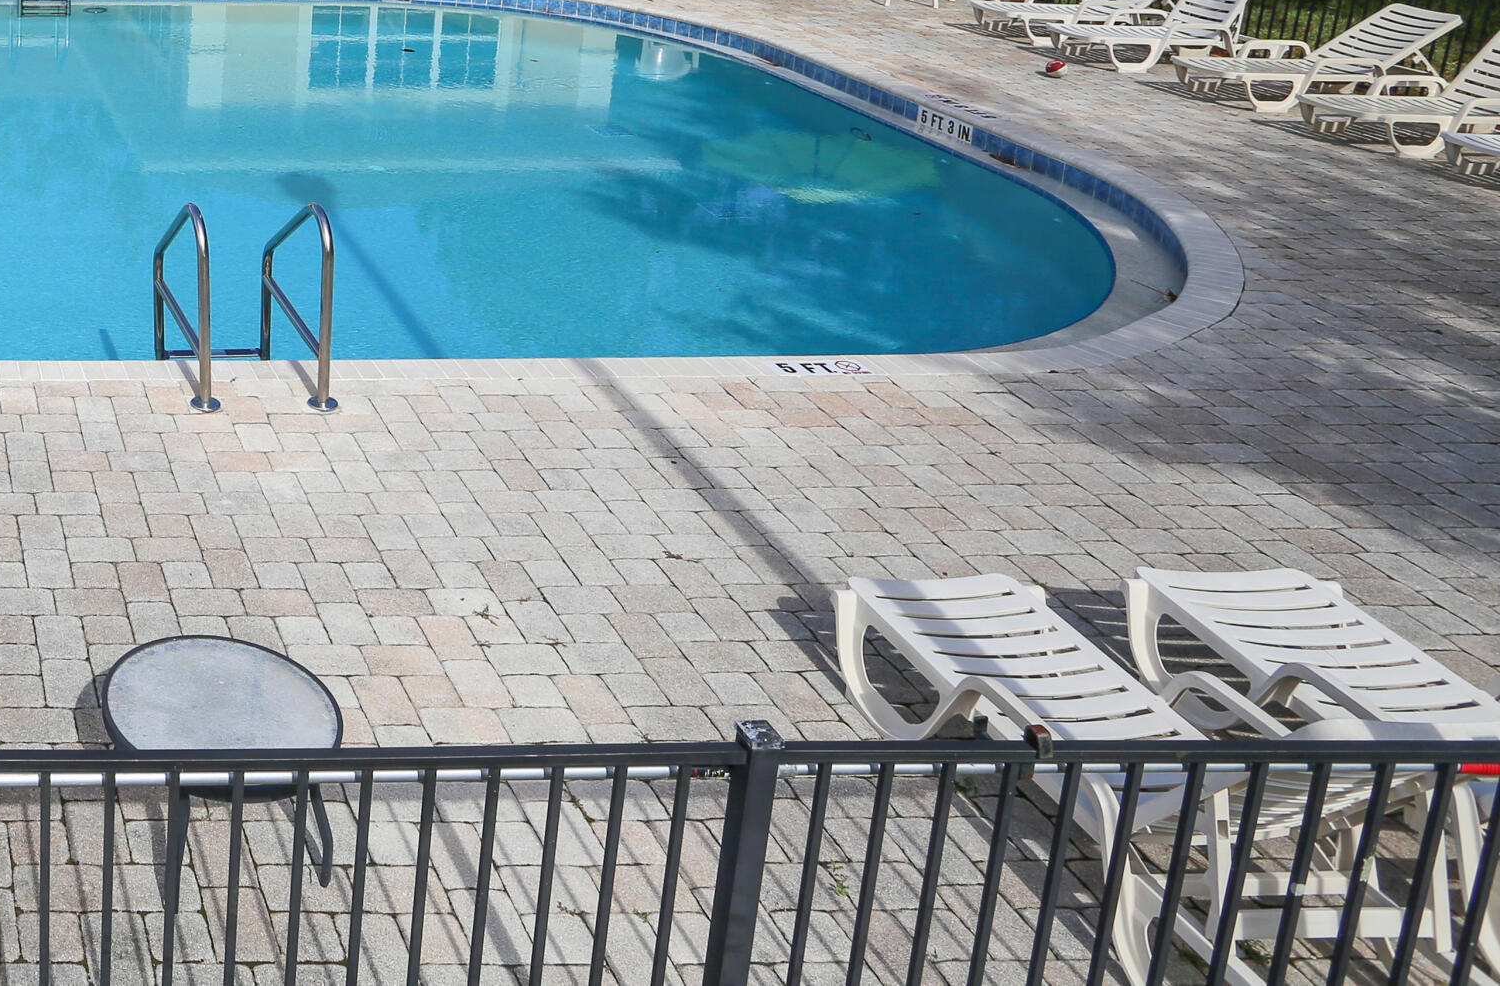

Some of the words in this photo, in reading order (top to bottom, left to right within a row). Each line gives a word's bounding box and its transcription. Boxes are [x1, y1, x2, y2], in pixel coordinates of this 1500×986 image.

[921, 110, 928, 124] 5
[947, 120, 955, 134] 3
[775, 362, 798, 374] 5
[799, 362, 838, 374] FT.
